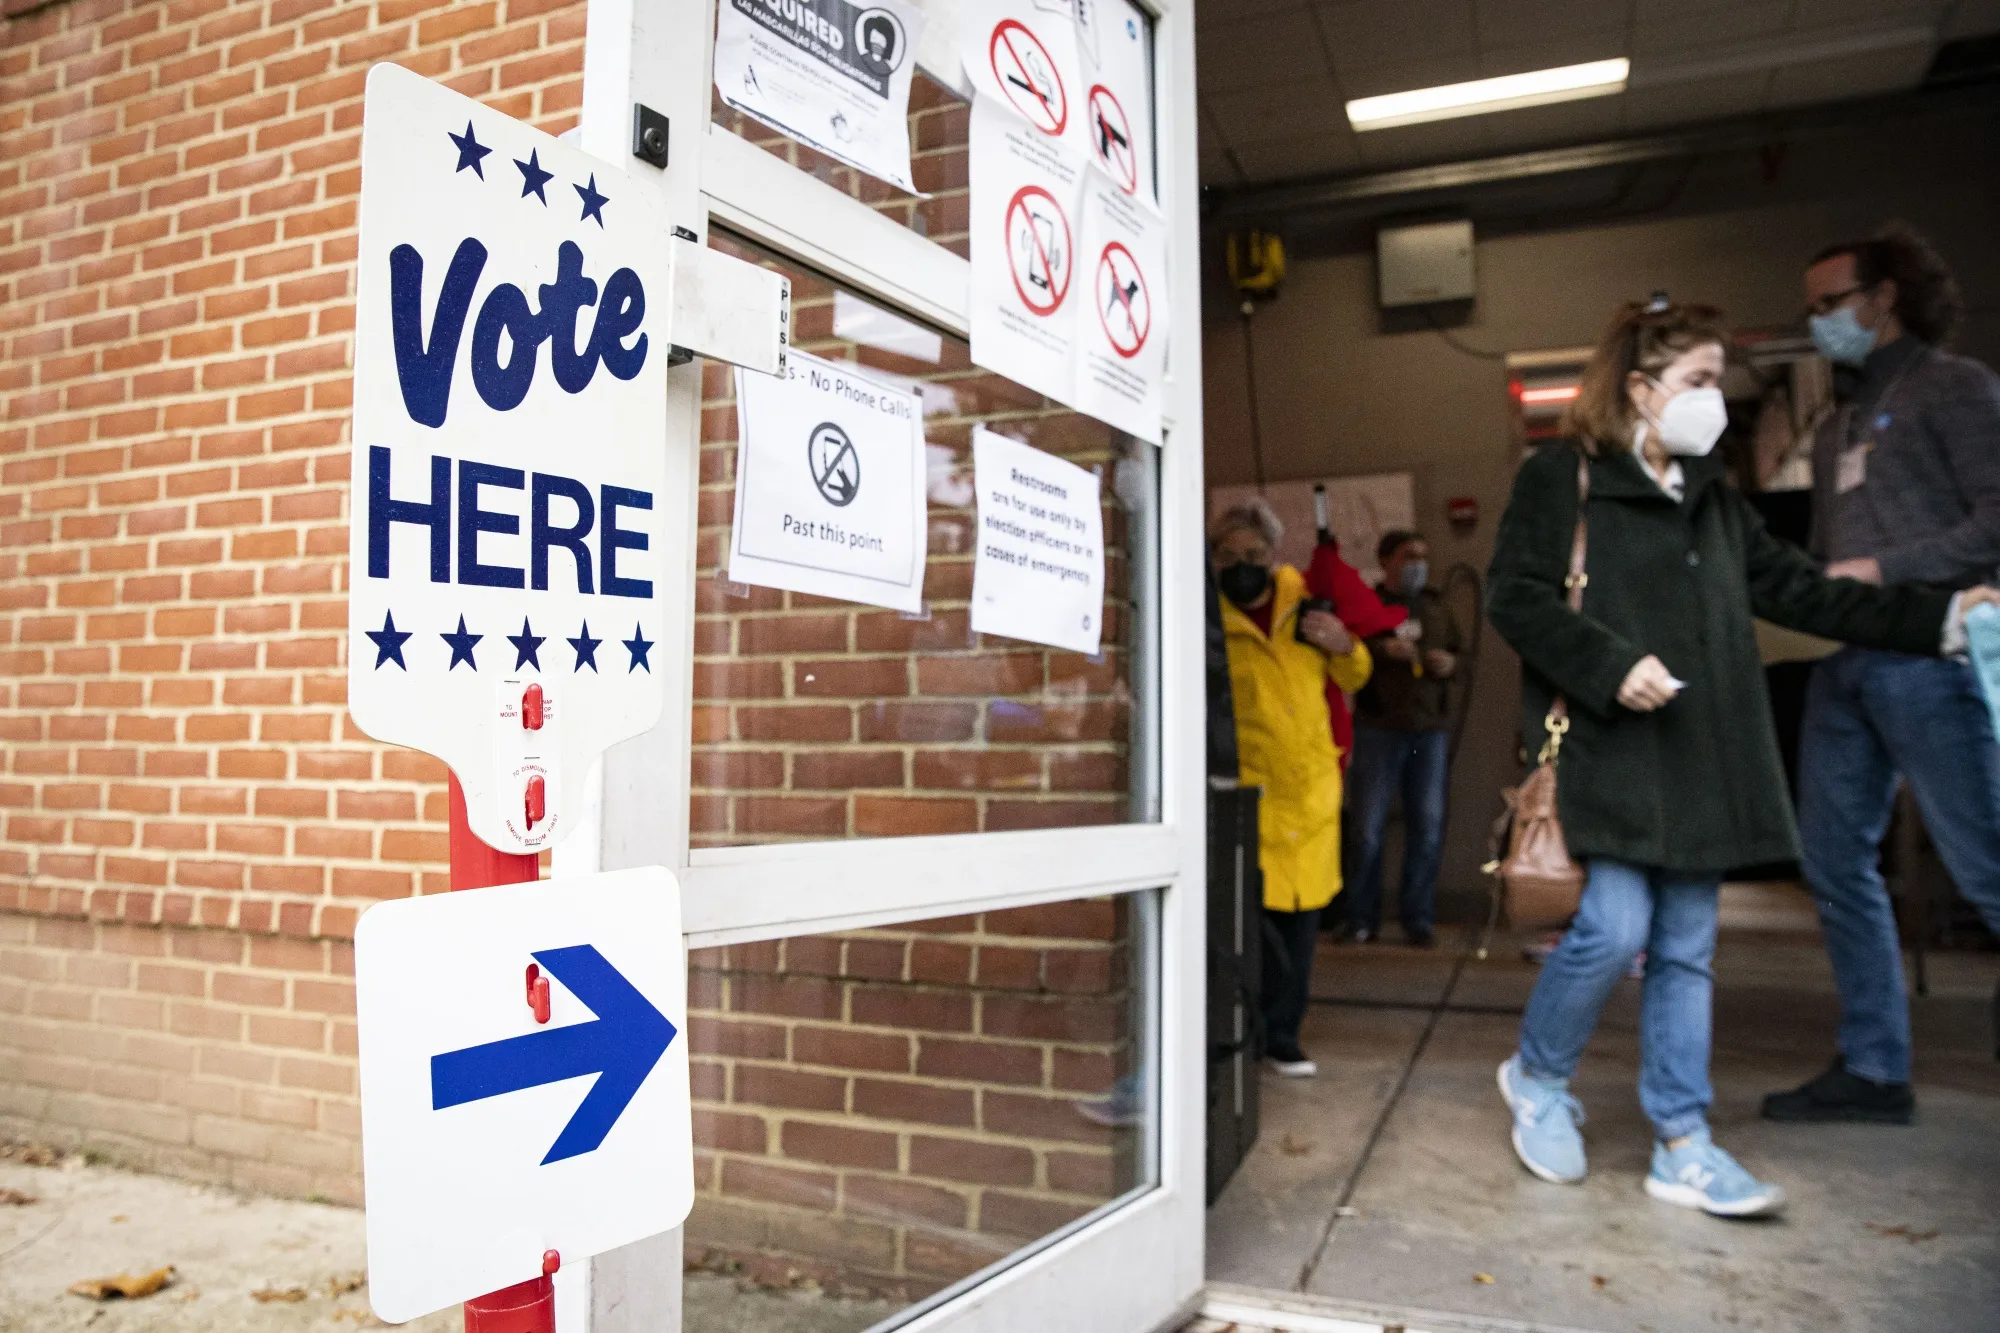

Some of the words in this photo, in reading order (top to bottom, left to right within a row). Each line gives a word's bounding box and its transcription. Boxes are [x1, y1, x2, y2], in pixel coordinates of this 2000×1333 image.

[758, 0, 844, 50] QUIRED
[390, 236, 648, 429] Vote
[779, 289, 788, 367] PUSH
[810, 370, 830, 392] No
[836, 377, 876, 409] Phone
[880, 396, 911, 419] Calls
[1011, 467, 1068, 500] Restrooms
[368, 445, 653, 599] HERE
[783, 514, 814, 539] Past
[820, 521, 845, 544] this
[849, 530, 883, 552] point
[985, 514, 1026, 538] election
[1049, 510, 1071, 530] only
[1074, 516, 1087, 534] by
[1017, 552, 1028, 567] of
[1030, 557, 1091, 587] emergency
[512, 769, 520, 778] TO
[521, 764, 548, 775] DISMOUNT
[506, 819, 523, 843] REMOVE
[524, 833, 547, 844] BOTTOM
[547, 813, 559, 832] FIRST
